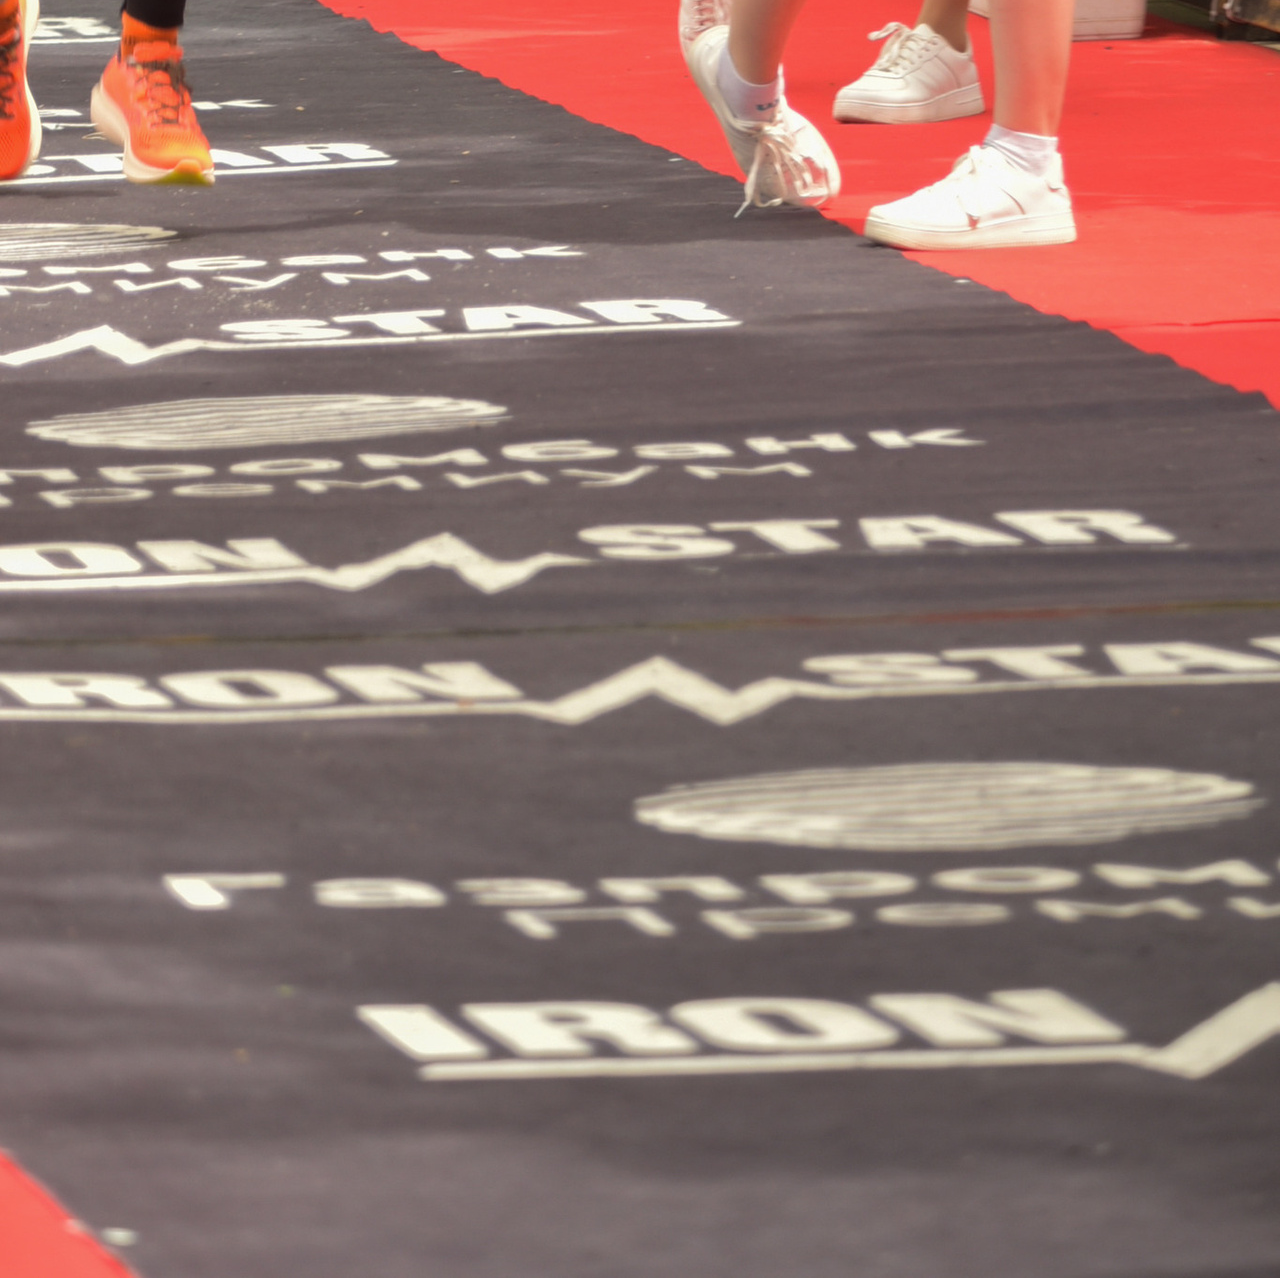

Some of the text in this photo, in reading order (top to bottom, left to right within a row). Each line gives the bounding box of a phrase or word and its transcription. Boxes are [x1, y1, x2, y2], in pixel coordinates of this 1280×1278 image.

[218, 299, 730, 341] STAR
[578, 509, 1178, 561] STAR
[802, 634, 1280, 685] STA
[162, 858, 1280, 911] Газпром
[505, 896, 1280, 941] Прем
[356, 988, 1128, 1062] IRON
